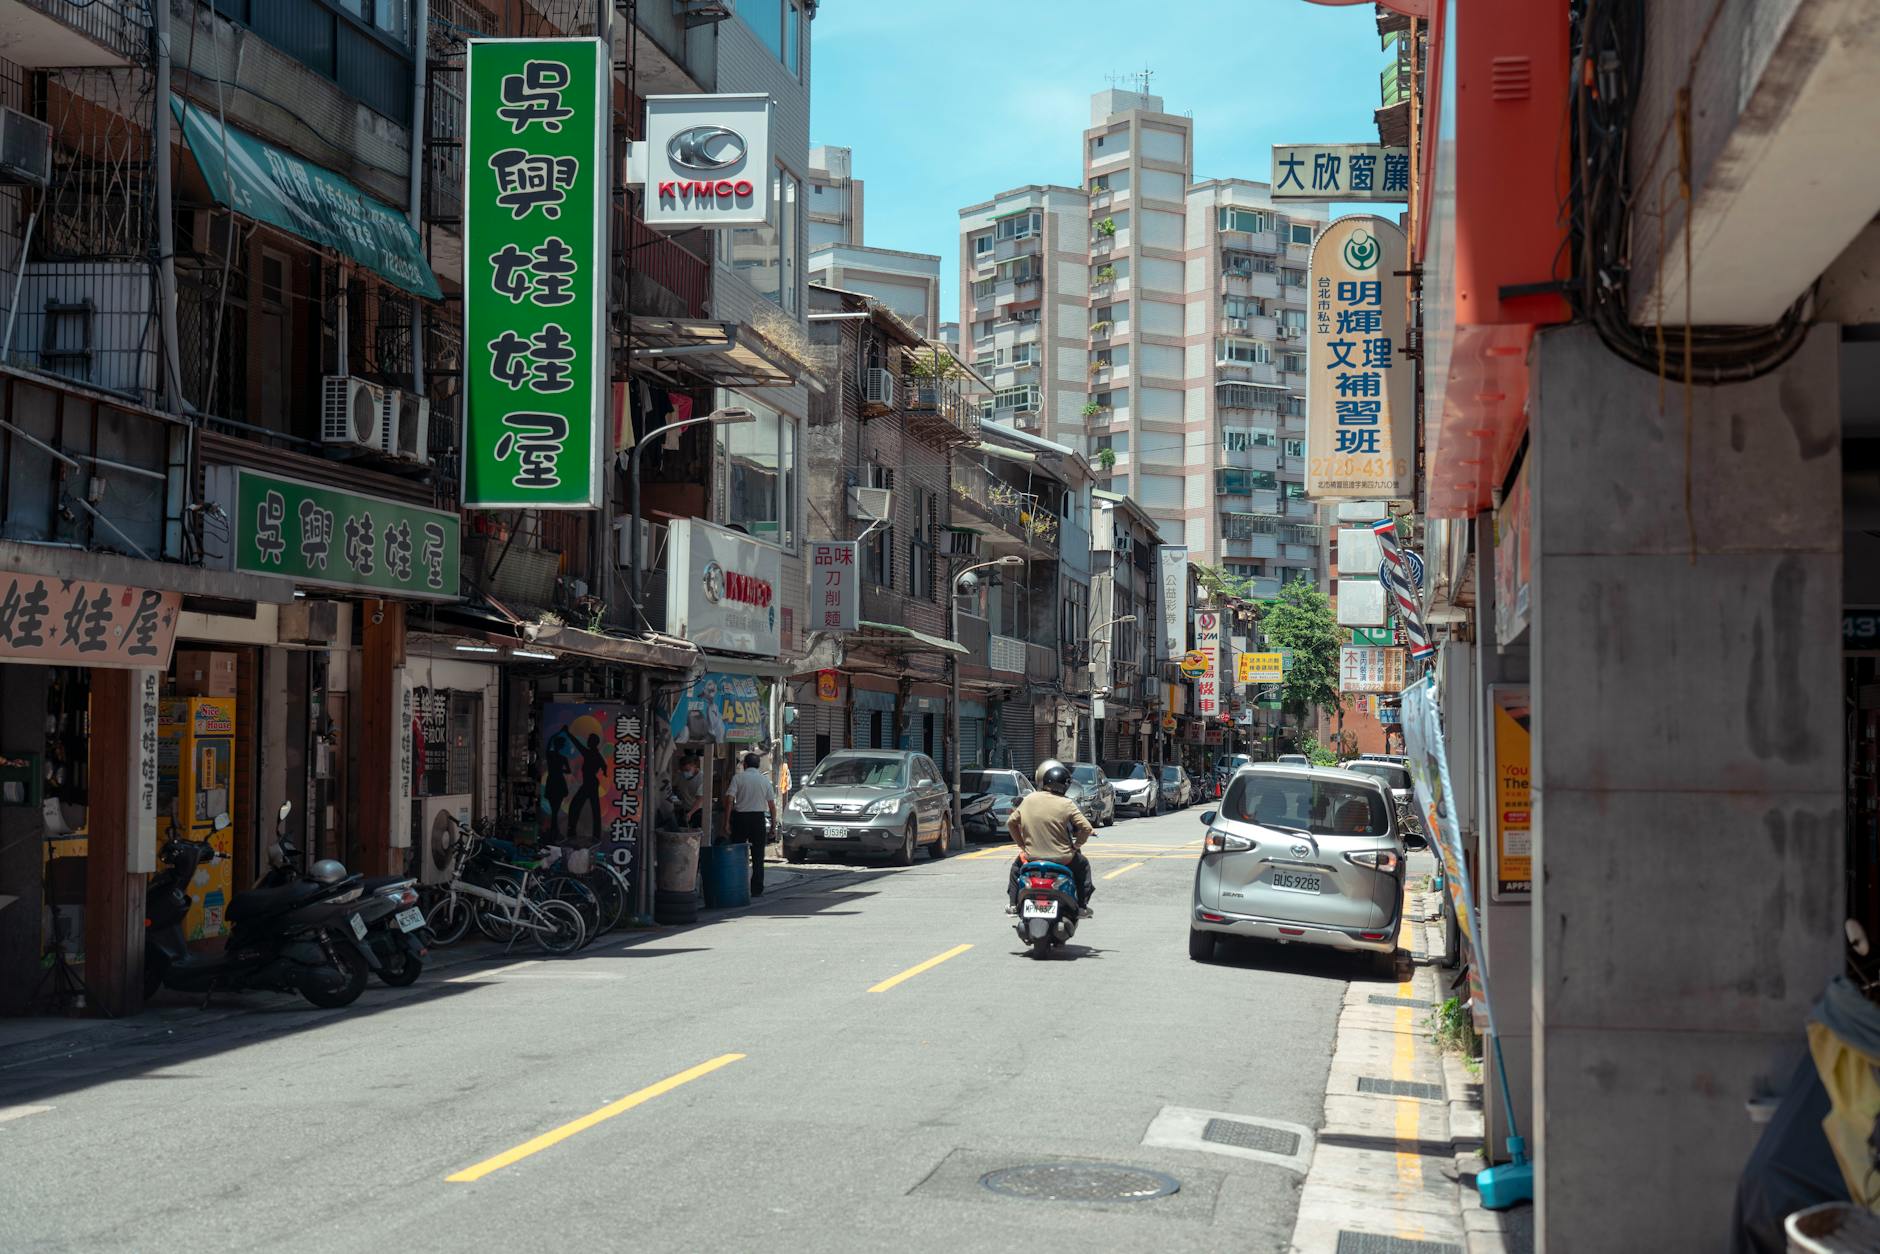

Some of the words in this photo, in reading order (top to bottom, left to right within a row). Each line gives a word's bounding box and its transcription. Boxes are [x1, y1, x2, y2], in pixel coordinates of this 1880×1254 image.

[658, 179, 754, 199] KYMCO
[1277, 152, 1408, 192] 大欣窗簾
[488, 59, 579, 488] 吳興娃娃屋
[1317, 276, 1331, 335] 台北市私立
[1326, 280, 1393, 455] 明輝文理補習班
[254, 489, 446, 589] 吳興娃娃屋
[815, 545, 854, 566] 品味
[824, 570, 841, 627] 刀削麵
[1165, 574, 1177, 625] 公益彩券
[0, 578, 163, 656] 娃娃屋
[1197, 632, 1219, 641] SYM
[1343, 650, 1360, 680] 木工
[200, 704, 221, 718] Nice
[207, 719, 232, 731] House
[422, 727, 446, 744] 卡拉OK
[1273, 873, 1321, 891] BUS-9283
